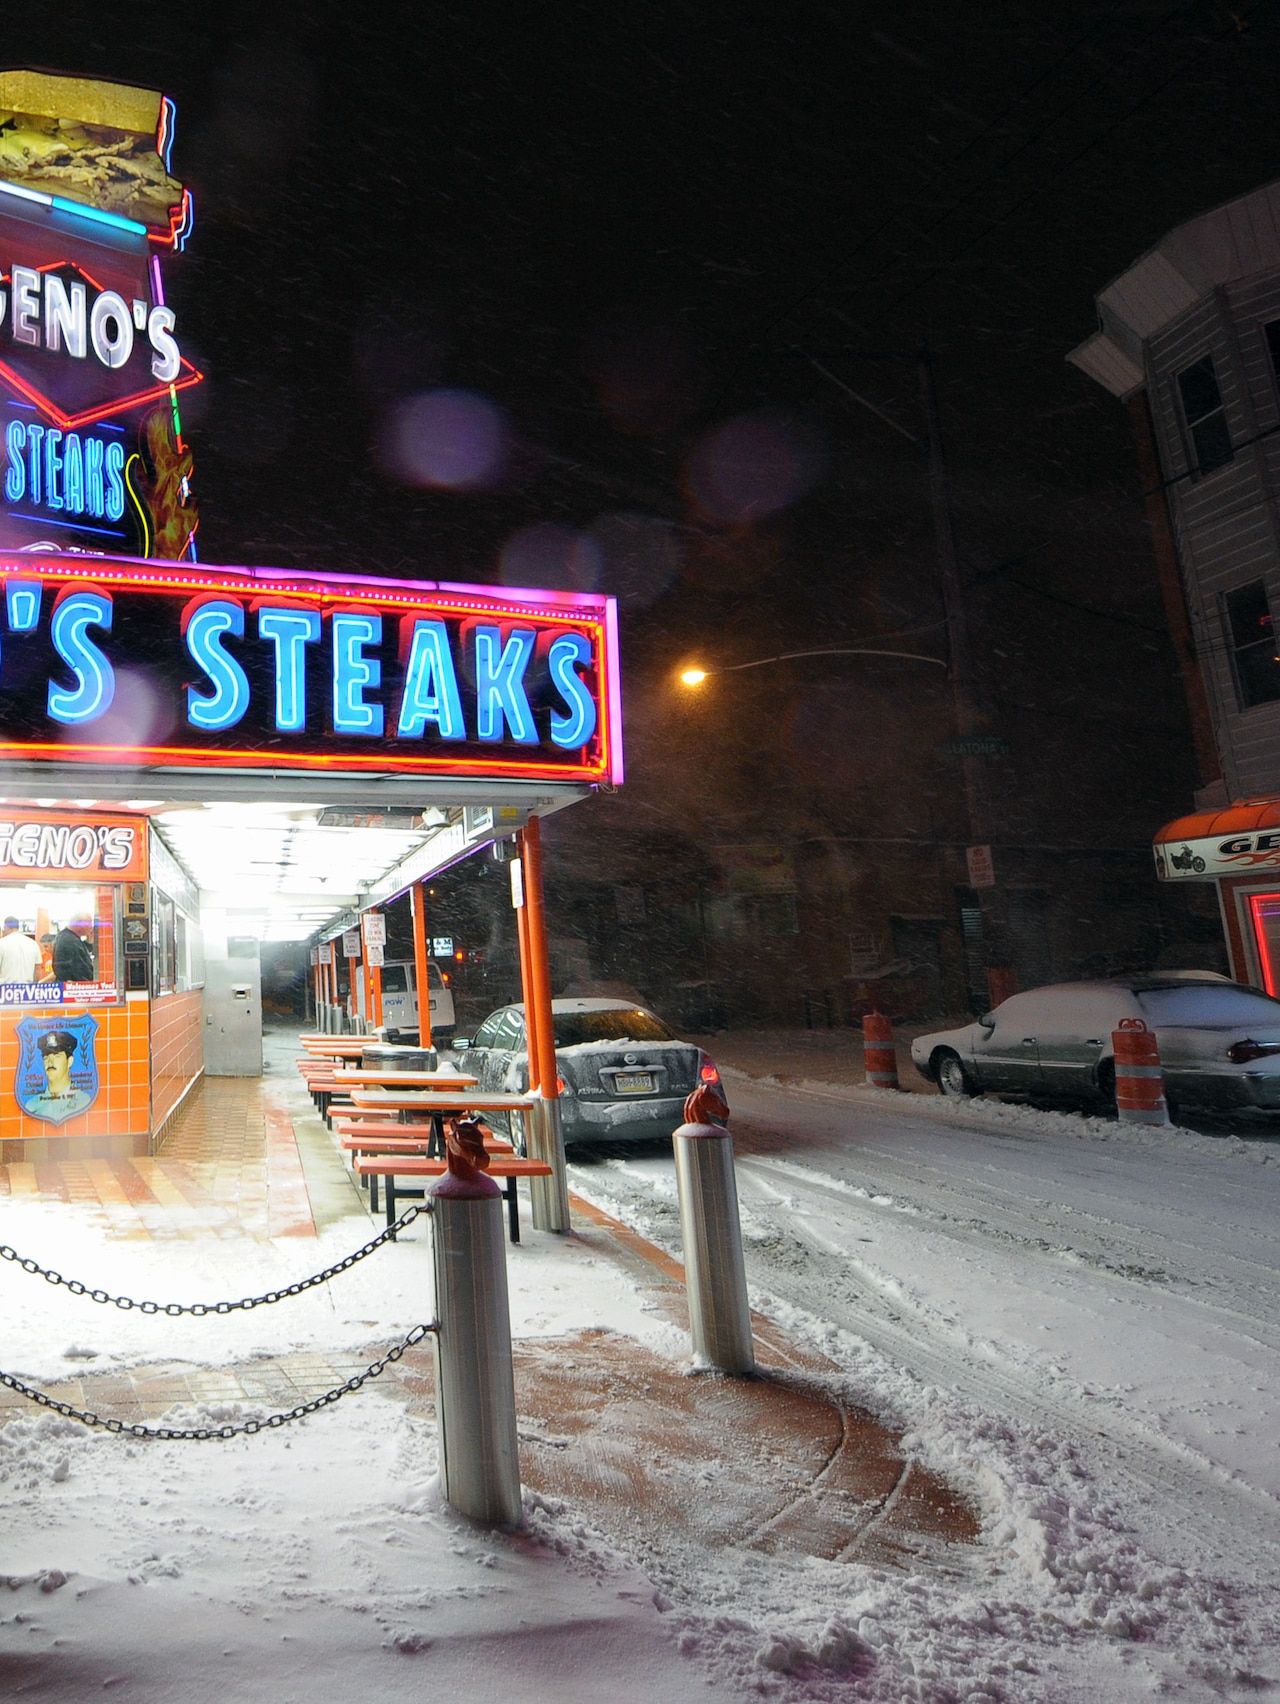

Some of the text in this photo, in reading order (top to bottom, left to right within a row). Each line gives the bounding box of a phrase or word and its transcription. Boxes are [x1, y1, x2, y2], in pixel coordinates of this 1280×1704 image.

[5, 419, 125, 520] STEAKS
[183, 594, 594, 749] STEAKS
[25, 984, 61, 1000] VENTO
